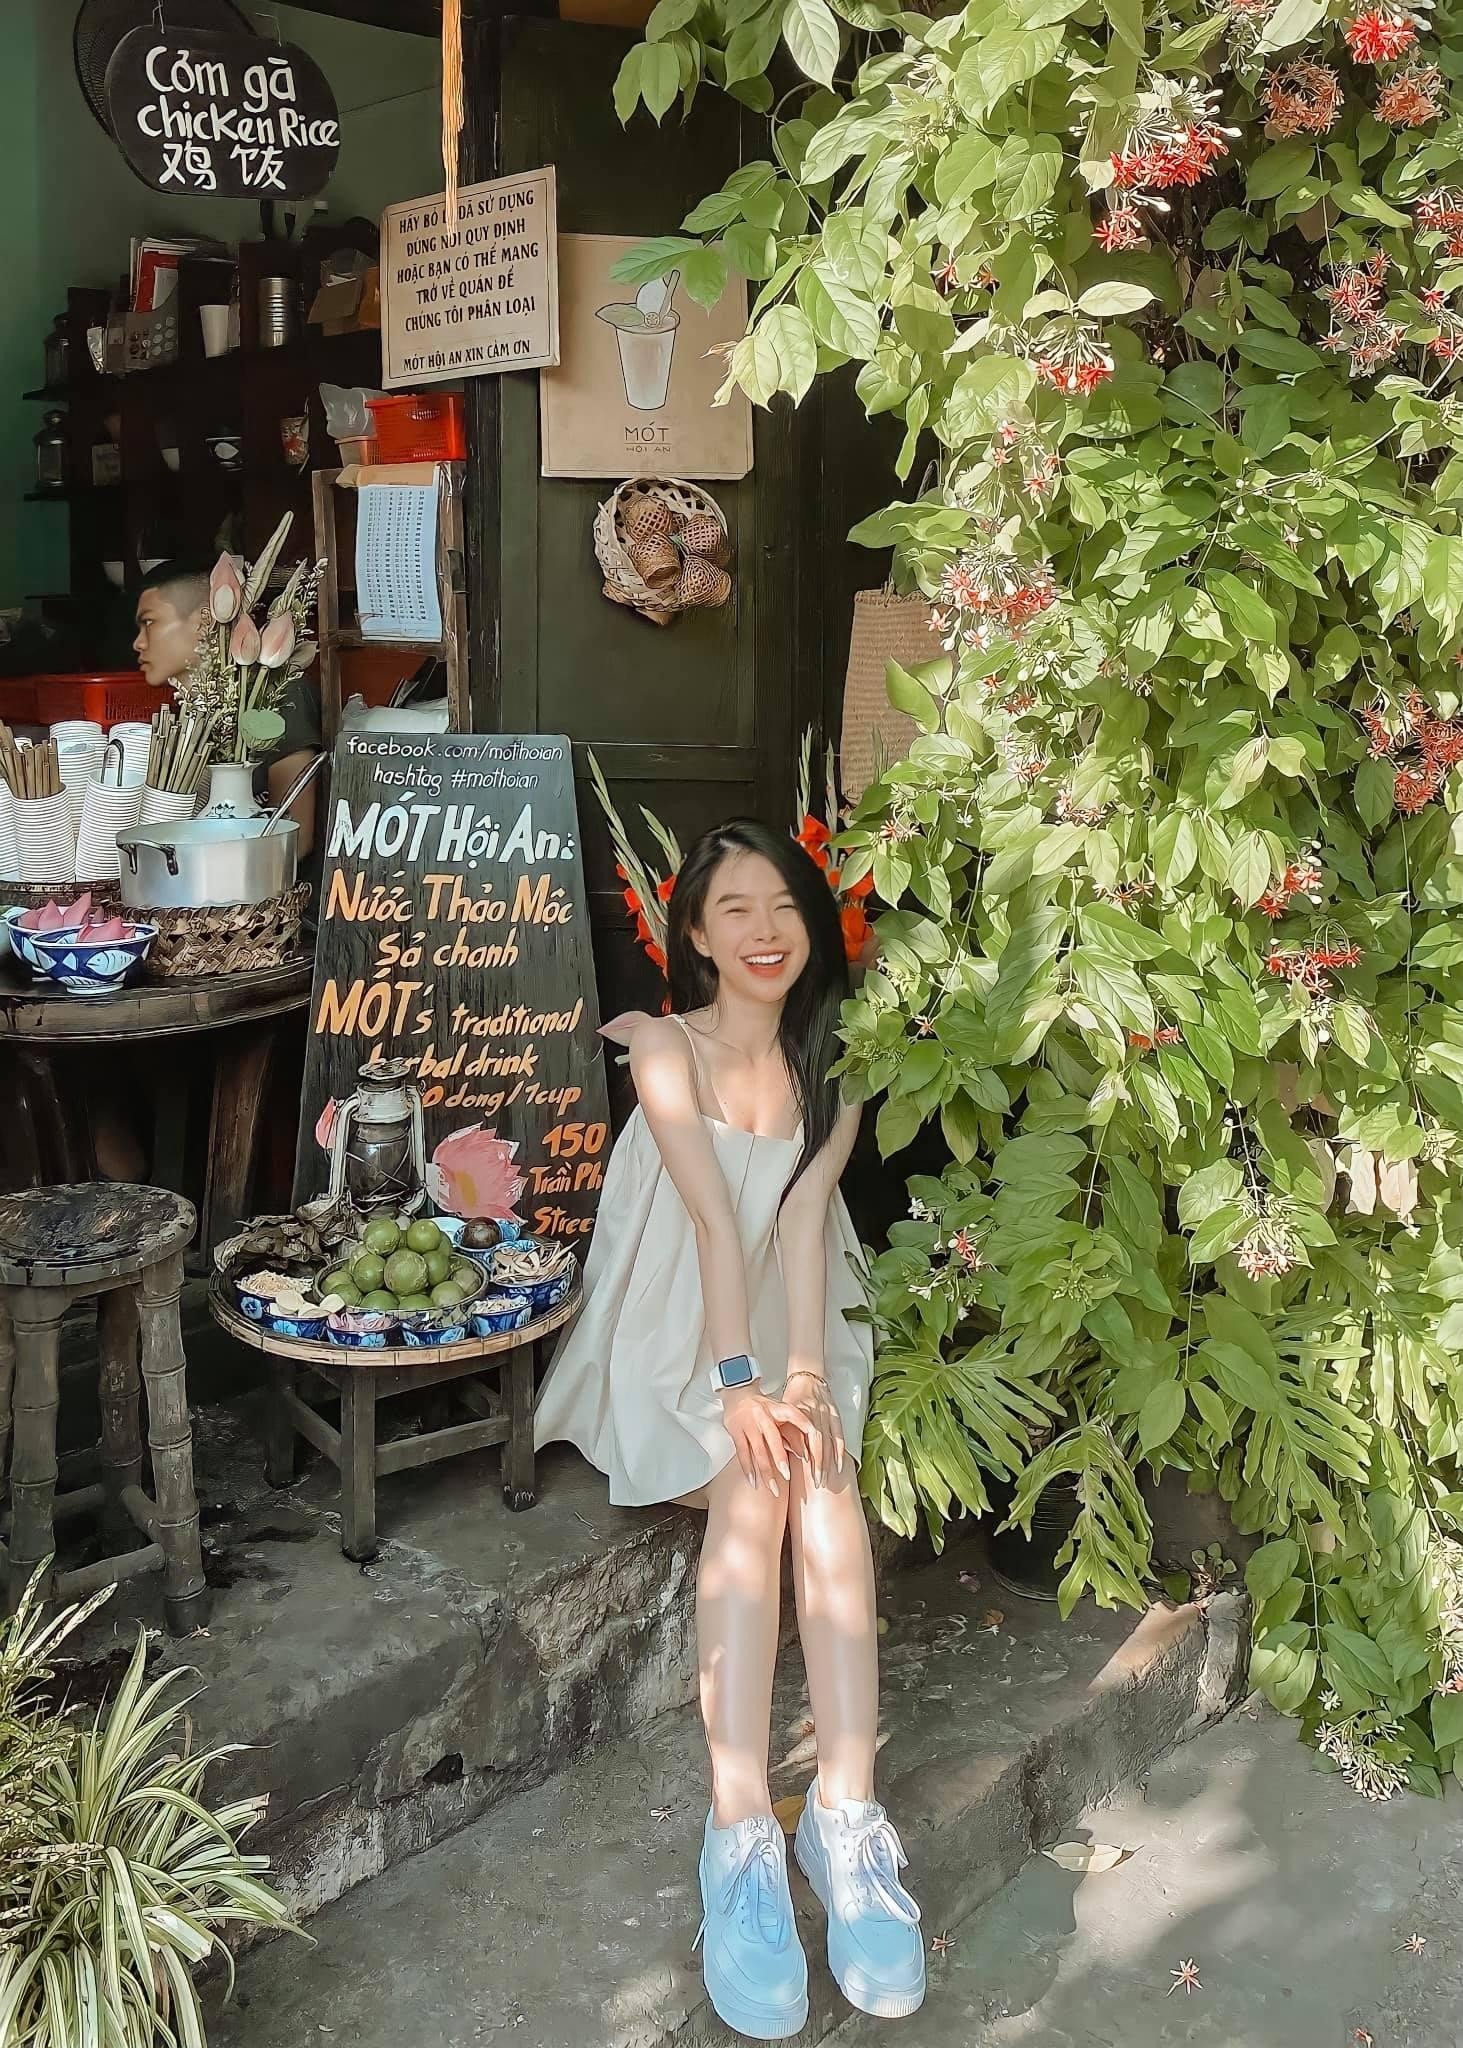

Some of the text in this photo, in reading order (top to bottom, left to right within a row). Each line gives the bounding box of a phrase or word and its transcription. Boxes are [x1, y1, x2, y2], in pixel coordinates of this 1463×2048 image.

[279, 107, 340, 148] Rice
[499, 190, 535, 212] DỤNG
[465, 226, 490, 246] QUY
[455, 251, 470, 271] CÓ
[501, 242, 539, 264] MANG
[459, 273, 493, 298] QUÁN
[405, 311, 441, 332] CHÚNG
[468, 299, 501, 320] PHÂN
[506, 296, 536, 317] LOẠI
[448, 350, 462, 366] AN
[465, 346, 484, 363] XIN
[624, 421, 670, 442] MÓT
[347, 736, 563, 760] facebook.com/mothoian
[373, 762, 539, 797] hashtag #mothoian
[327, 791, 441, 862] MÓT
[422, 873, 506, 924] Thảo
[432, 926, 519, 968] chanh
[451, 998, 584, 1037] traditional
[464, 1043, 540, 1077] drink
[541, 1122, 607, 1158] 150
